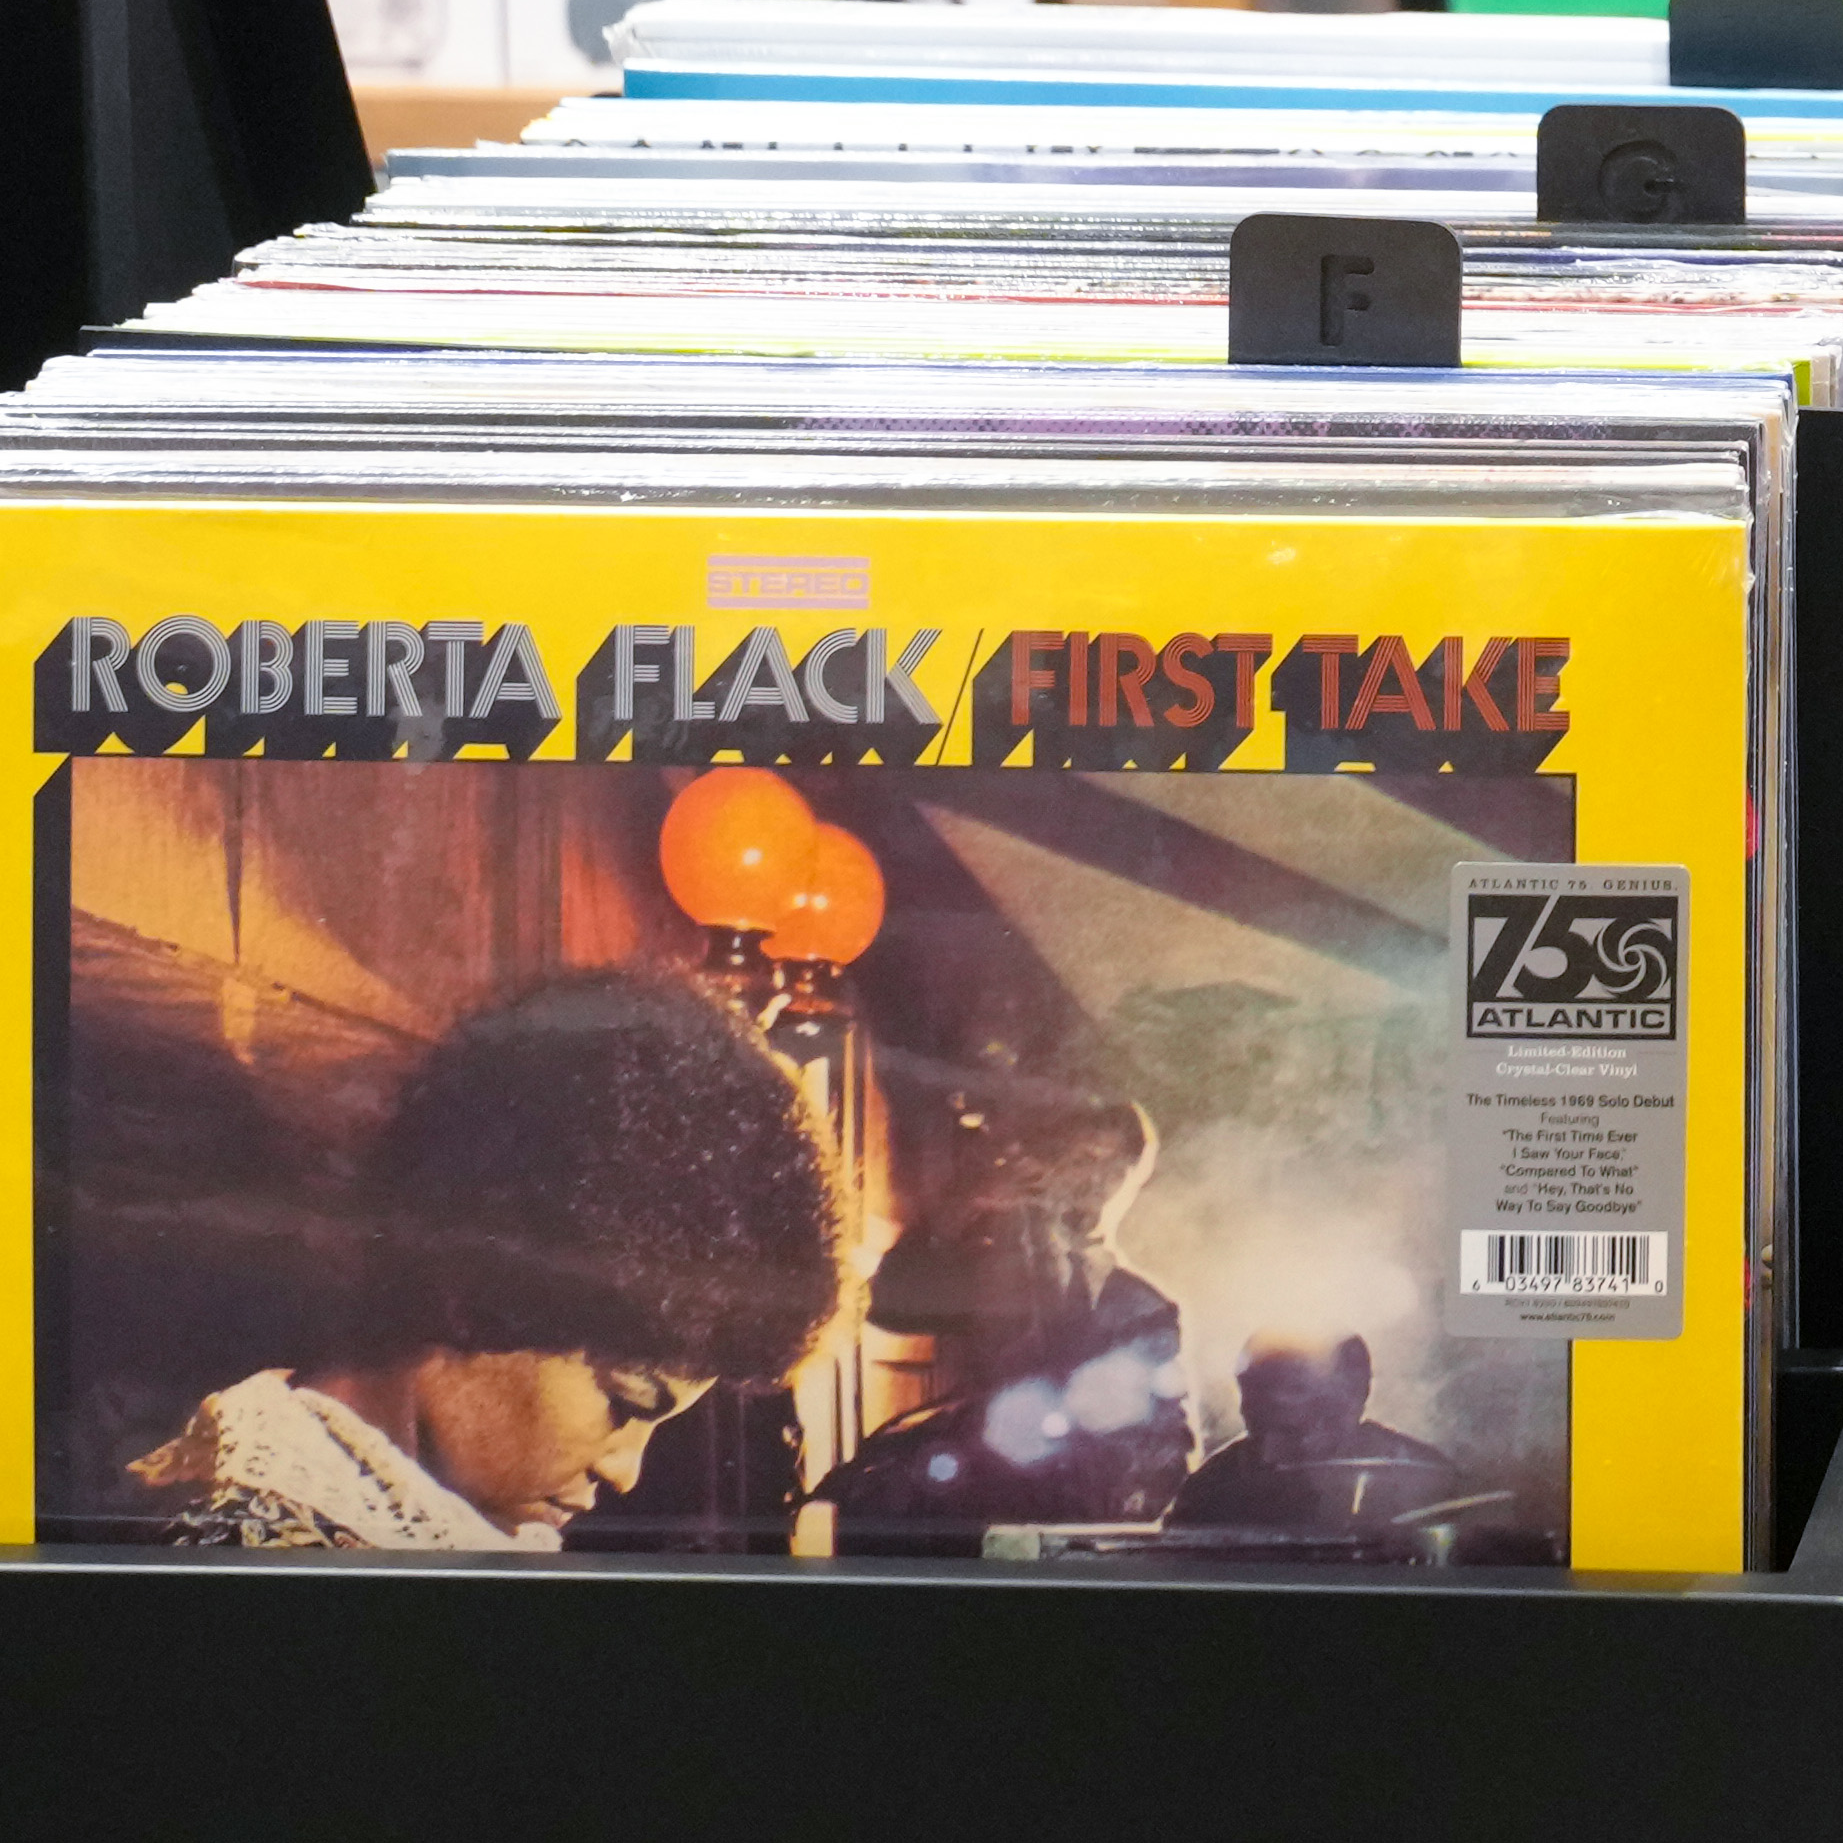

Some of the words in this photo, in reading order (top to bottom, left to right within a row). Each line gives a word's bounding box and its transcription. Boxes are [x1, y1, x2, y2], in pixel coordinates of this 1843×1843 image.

[1318, 253, 1375, 346] F
[708, 569, 870, 598] STEREO
[70, 615, 562, 722] ROBERTA
[1009, 630, 1274, 732] FIRST
[1301, 633, 1571, 734] TAKE
[1468, 877, 1559, 890] ATLANTIC
[1602, 878, 1679, 891] GENIUS.
[1476, 1007, 1666, 1030] ATLANTIC
[1507, 1044, 1628, 1059] Limited-Edition
[1495, 1061, 1595, 1079] Crystal-Clear
[1599, 1062, 1639, 1080] Vinyl
[1466, 1092, 1492, 1107] The
[1496, 1092, 1557, 1107] Timeless
[1560, 1092, 1595, 1107] 1969
[1598, 1094, 1631, 1108] Solo
[1633, 1094, 1675, 1108] Debut
[1540, 1112, 1600, 1128] Featuring
[1537, 1129, 1567, 1142] First
[1571, 1129, 1604, 1142] Time
[1607, 1129, 1639, 1142] Ever
[1520, 1148, 1550, 1160] Saw
[1554, 1148, 1585, 1160] Your
[1580, 1165, 1596, 1178] To
[1503, 1182, 1529, 1195] and
[1571, 1182, 1612, 1195] That's
[1614, 1182, 1634, 1195] No
[1495, 1200, 1523, 1214] Way
[1527, 1200, 1543, 1212] To
[1546, 1200, 1572, 1214] Say
[1505, 1276, 1563, 1293] 03497
[1572, 1276, 1630, 1293] 83741
[1654, 1280, 1664, 1294] 0
